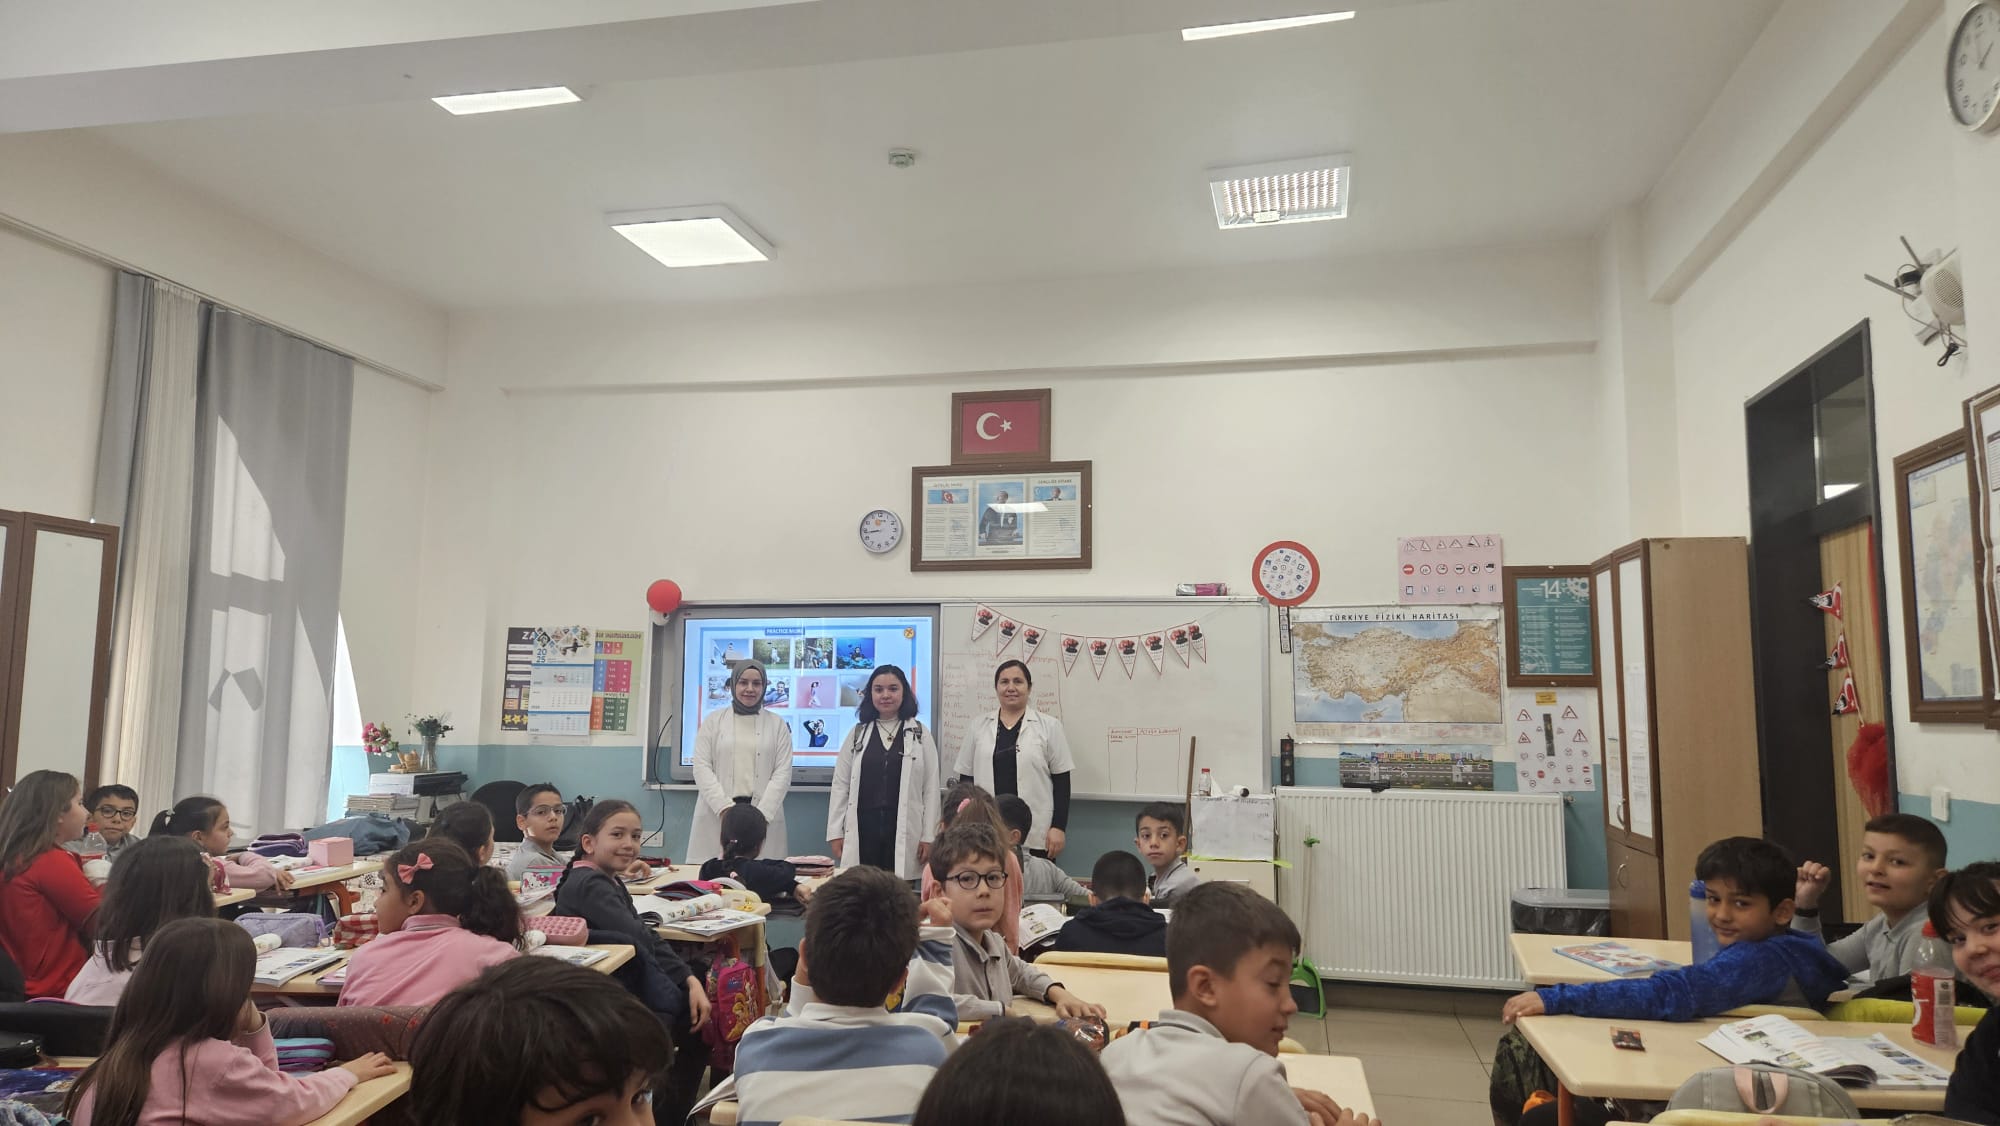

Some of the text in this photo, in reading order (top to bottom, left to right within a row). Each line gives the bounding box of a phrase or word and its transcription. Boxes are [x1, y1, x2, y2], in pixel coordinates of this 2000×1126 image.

[1539, 580, 1562, 599] 14
[1329, 613, 1369, 621] TÜRKİYE
[537, 648, 547, 656] 20
[536, 655, 546, 663] 25
